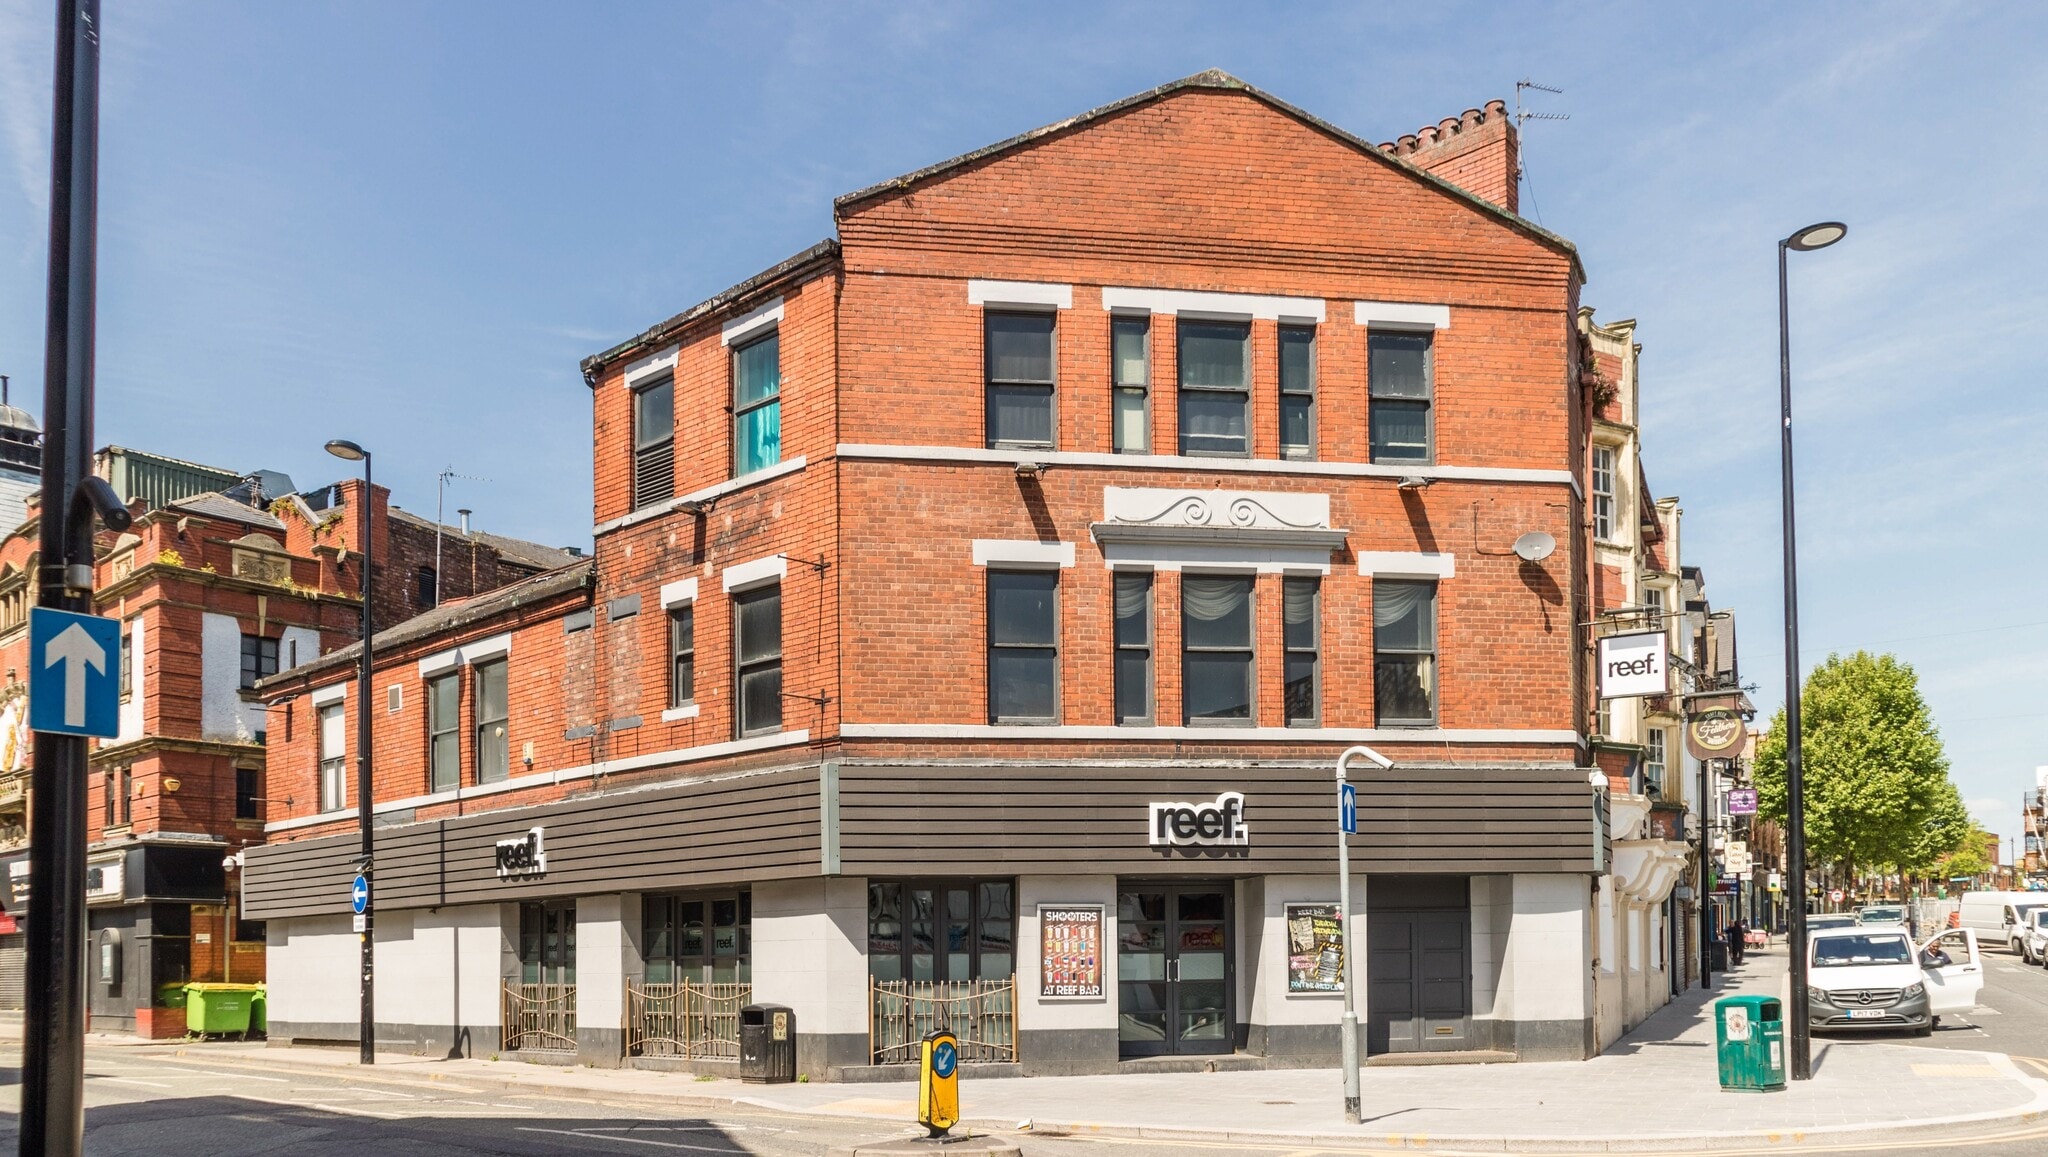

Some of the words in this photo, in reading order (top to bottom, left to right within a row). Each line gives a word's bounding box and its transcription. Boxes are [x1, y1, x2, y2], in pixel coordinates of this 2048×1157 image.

[1608, 653, 1658, 678] reef.
[1155, 796, 1245, 840] reef.
[496, 832, 540, 870] reef.
[1046, 911, 1098, 921] SHOOTERS
[716, 936, 734, 949] reef.
[1043, 985, 1055, 995] AT
[1056, 985, 1078, 995] REEF
[1079, 985, 1100, 995] BAR
